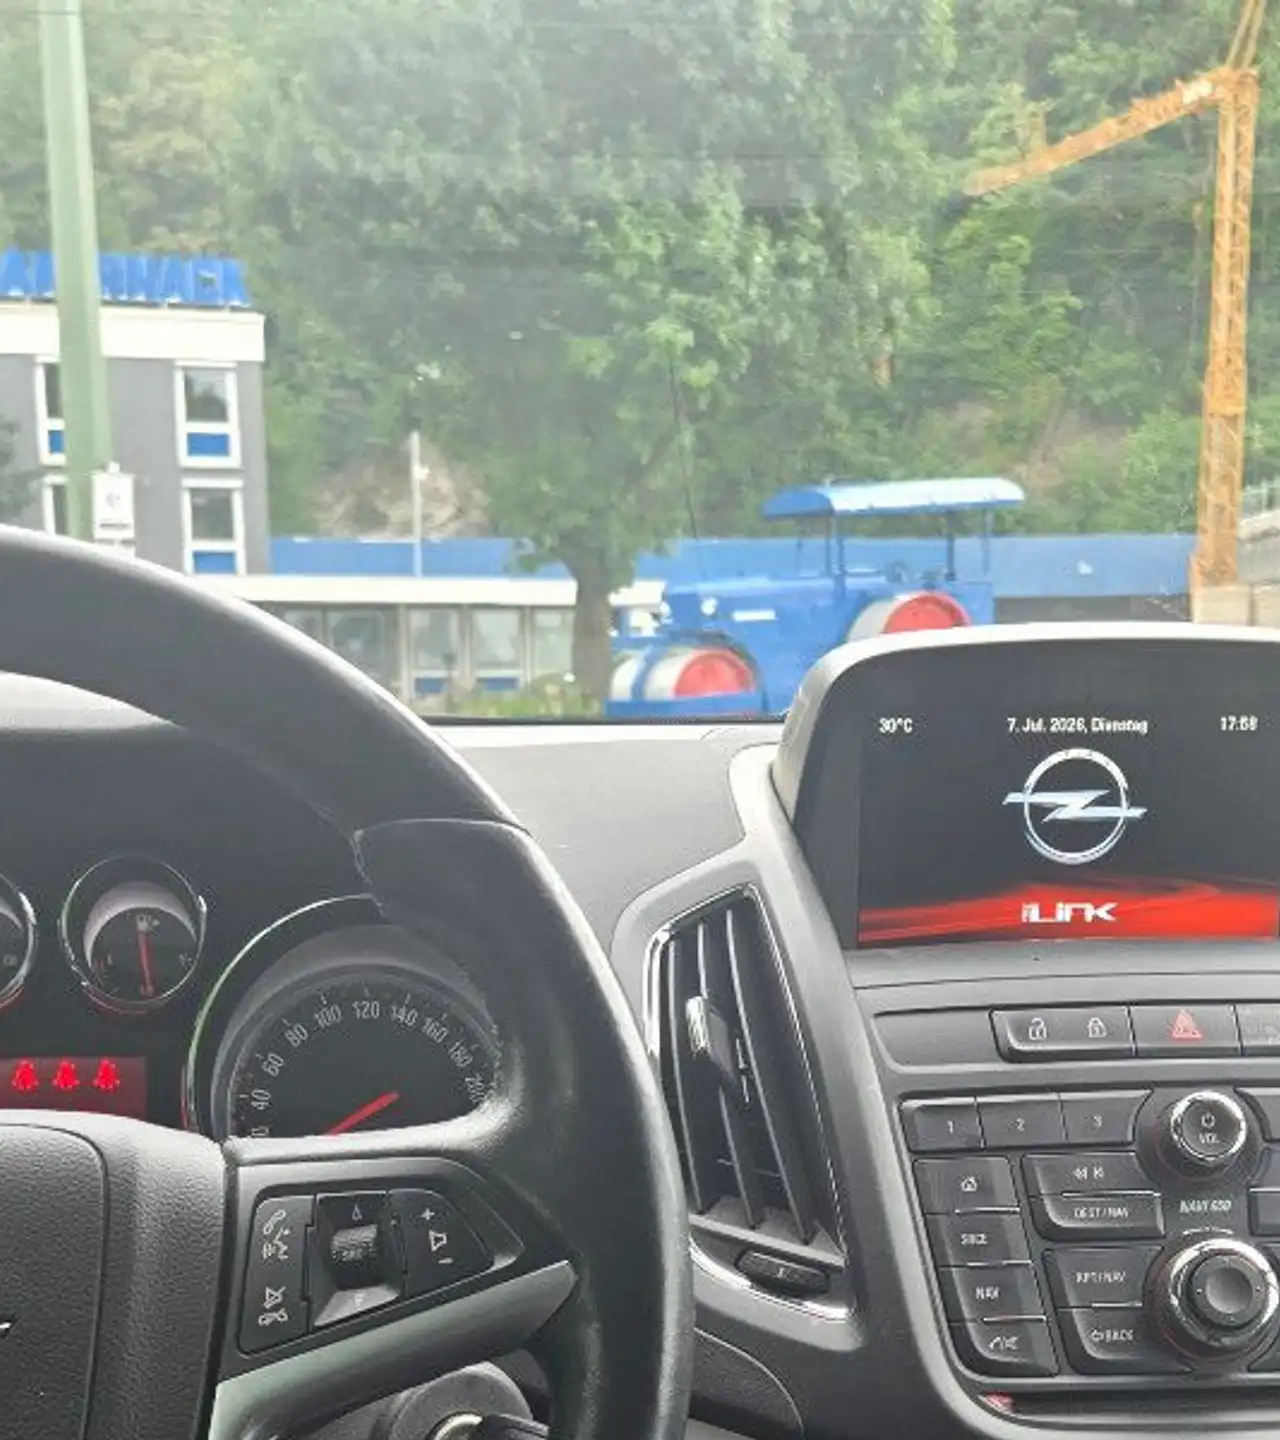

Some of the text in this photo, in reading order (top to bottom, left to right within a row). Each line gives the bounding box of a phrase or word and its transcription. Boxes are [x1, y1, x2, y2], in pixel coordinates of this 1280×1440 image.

[879, 717, 913, 733] 30°C
[1091, 717, 1149, 735] Dienstag
[313, 1004, 342, 1029] 100
[352, 1001, 381, 1020] 120
[391, 1003, 419, 1027] 140
[284, 1023, 309, 1048] 80
[421, 1017, 450, 1043] 160
[261, 1053, 285, 1077] 60
[447, 1041, 474, 1069] 180
[251, 1089, 271, 1111] 40
